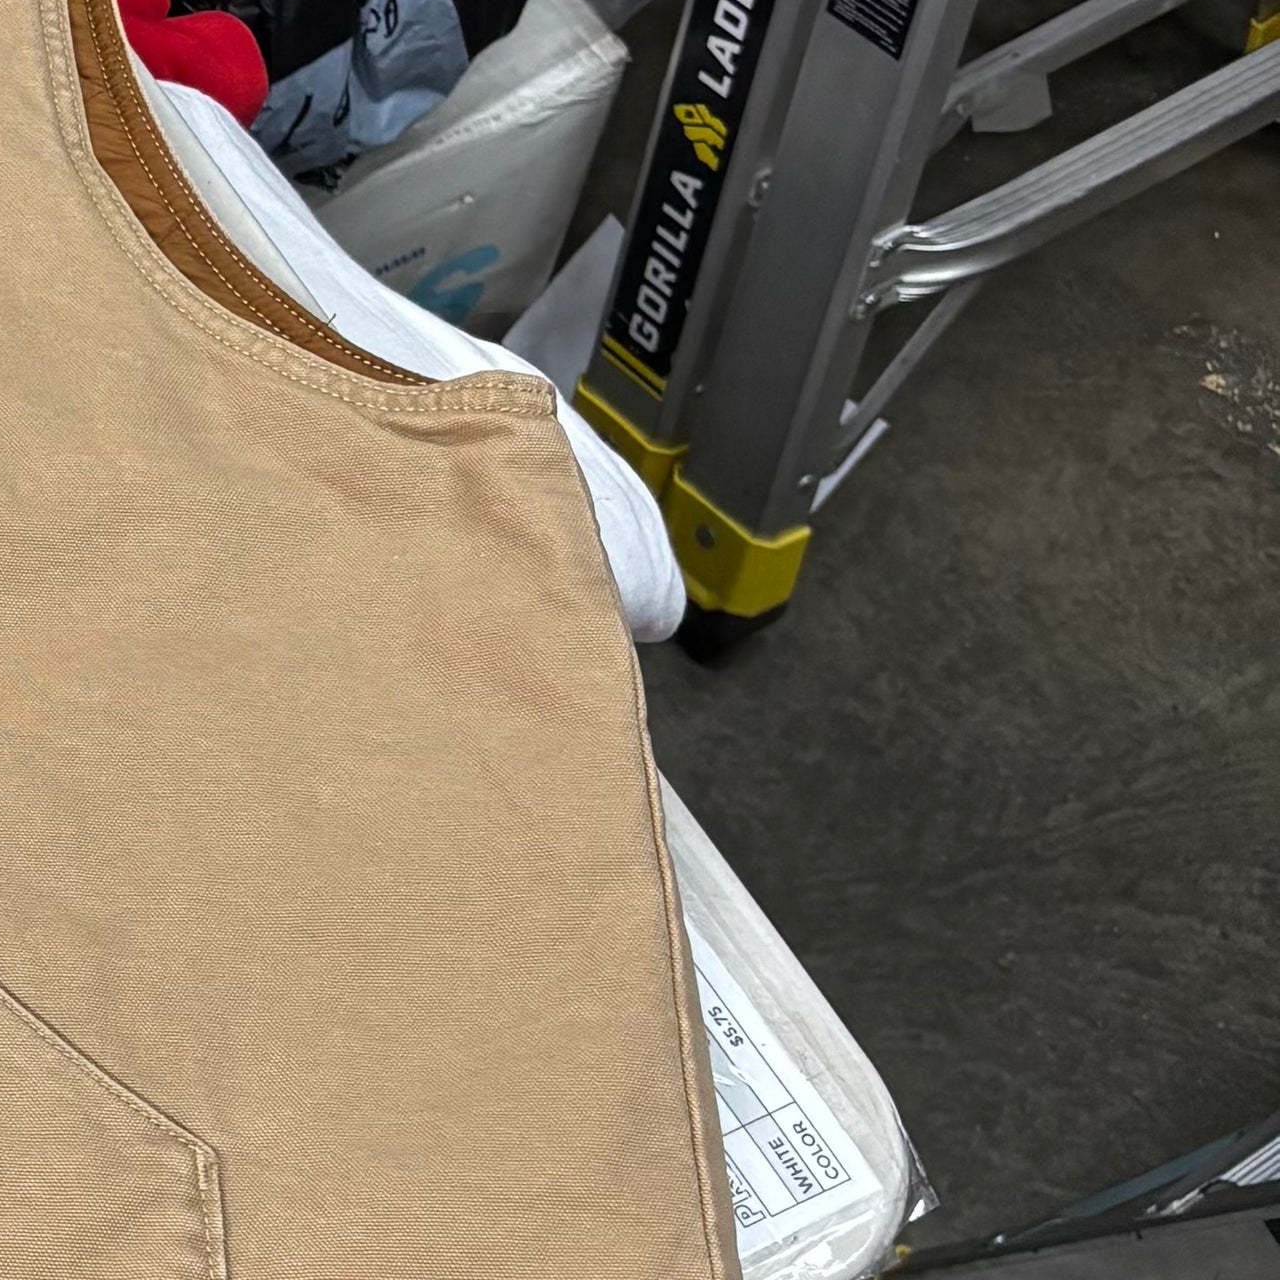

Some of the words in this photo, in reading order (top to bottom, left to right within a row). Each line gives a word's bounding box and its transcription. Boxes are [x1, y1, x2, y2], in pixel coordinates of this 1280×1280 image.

[628, 170, 703, 353] GORILLA
[708, 1006, 744, 1047] $5.75
[768, 1136, 813, 1195] WHITE
[793, 1120, 840, 1180] COLOR
